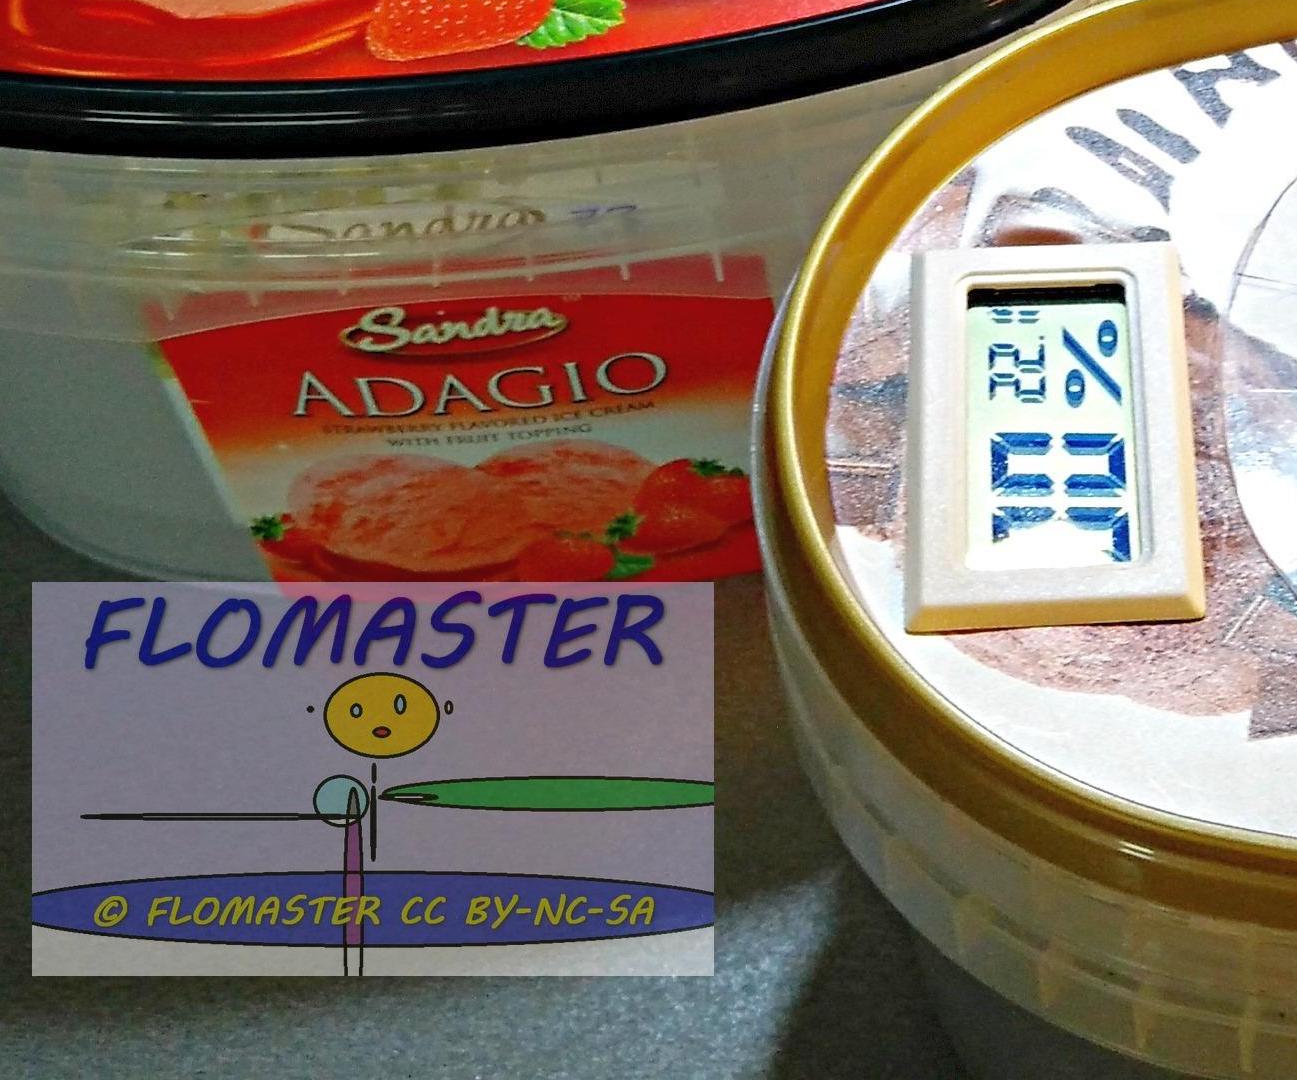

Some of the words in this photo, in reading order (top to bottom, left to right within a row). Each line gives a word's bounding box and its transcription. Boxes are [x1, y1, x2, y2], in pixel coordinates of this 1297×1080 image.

[355, 306, 562, 352] Sandra
[294, 352, 667, 418] ADAGIO
[322, 421, 443, 436] STRAWBERRY
[551, 408, 583, 424] ICE
[588, 400, 656, 418] CREAM
[386, 434, 439, 448] WITH
[446, 430, 500, 446] FRUIT
[505, 422, 593, 441] TOPPING
